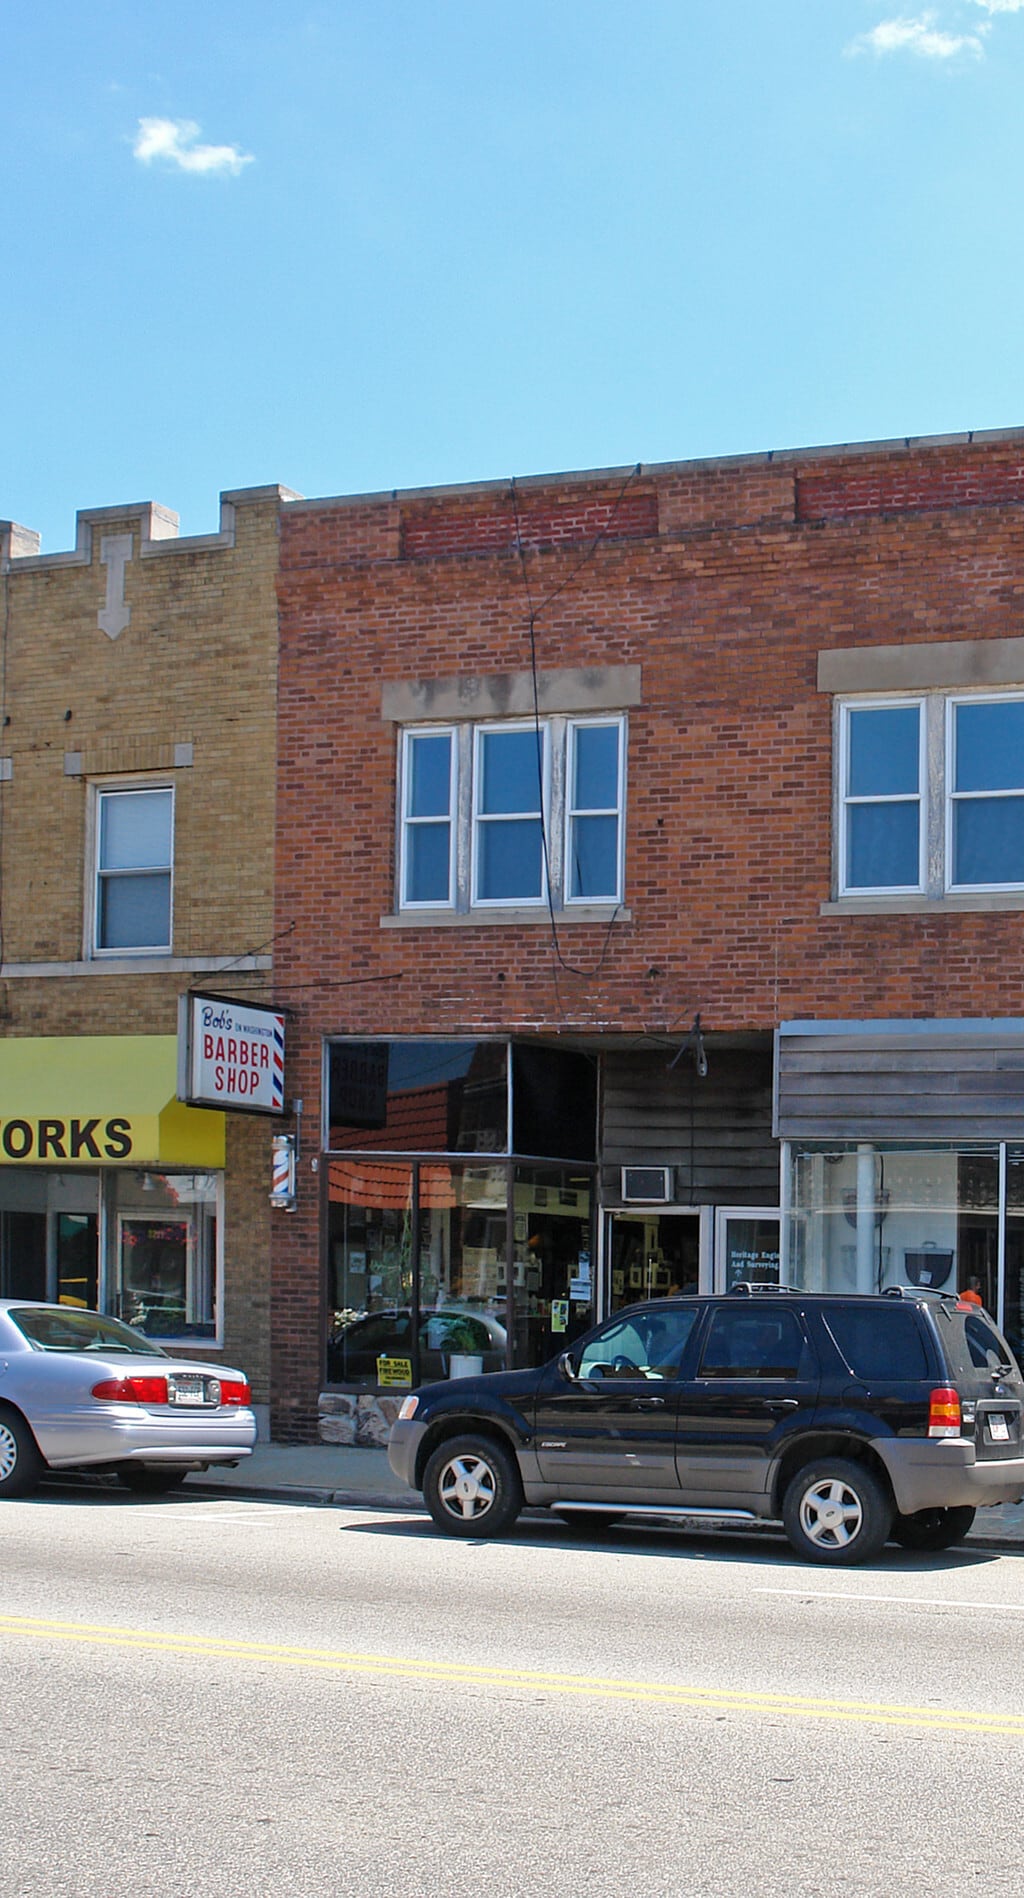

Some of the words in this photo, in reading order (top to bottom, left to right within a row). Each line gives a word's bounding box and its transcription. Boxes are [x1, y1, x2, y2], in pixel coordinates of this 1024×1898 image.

[202, 1006, 233, 1031] Bob's
[203, 1033, 269, 1069] BARBER
[214, 1065, 260, 1096] SHOP
[0, 1117, 133, 1159] ORKS
[731, 1251, 758, 1260] Heritage
[747, 1261, 779, 1270] Surveying
[393, 1360, 408, 1368] SALE
